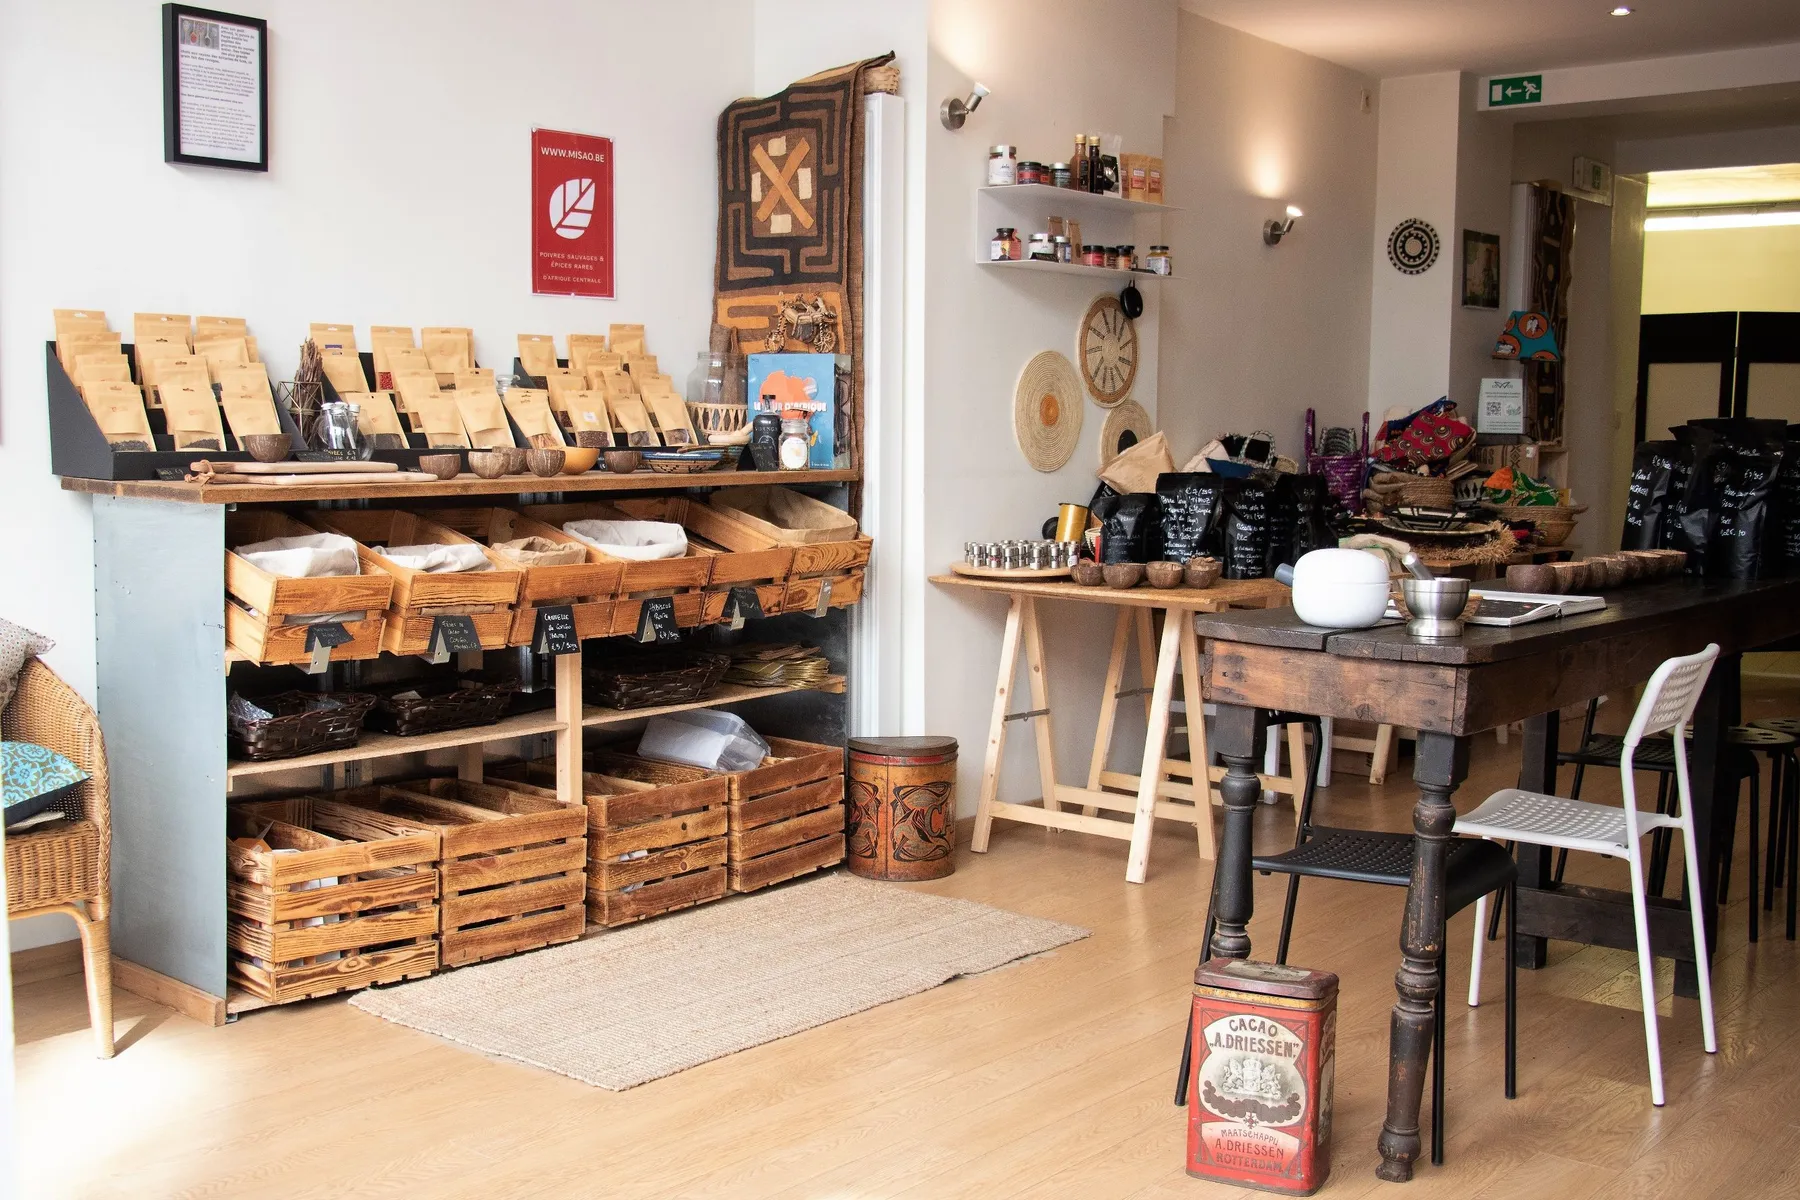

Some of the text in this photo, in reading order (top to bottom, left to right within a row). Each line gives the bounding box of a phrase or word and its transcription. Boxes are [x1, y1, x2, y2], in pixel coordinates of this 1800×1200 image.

[541, 147, 604, 162] WWW.MISAO.BE
[567, 254, 598, 262] SAUVAGES
[551, 260, 572, 269] ÉPICES
[1229, 1018, 1278, 1037] CACAO
